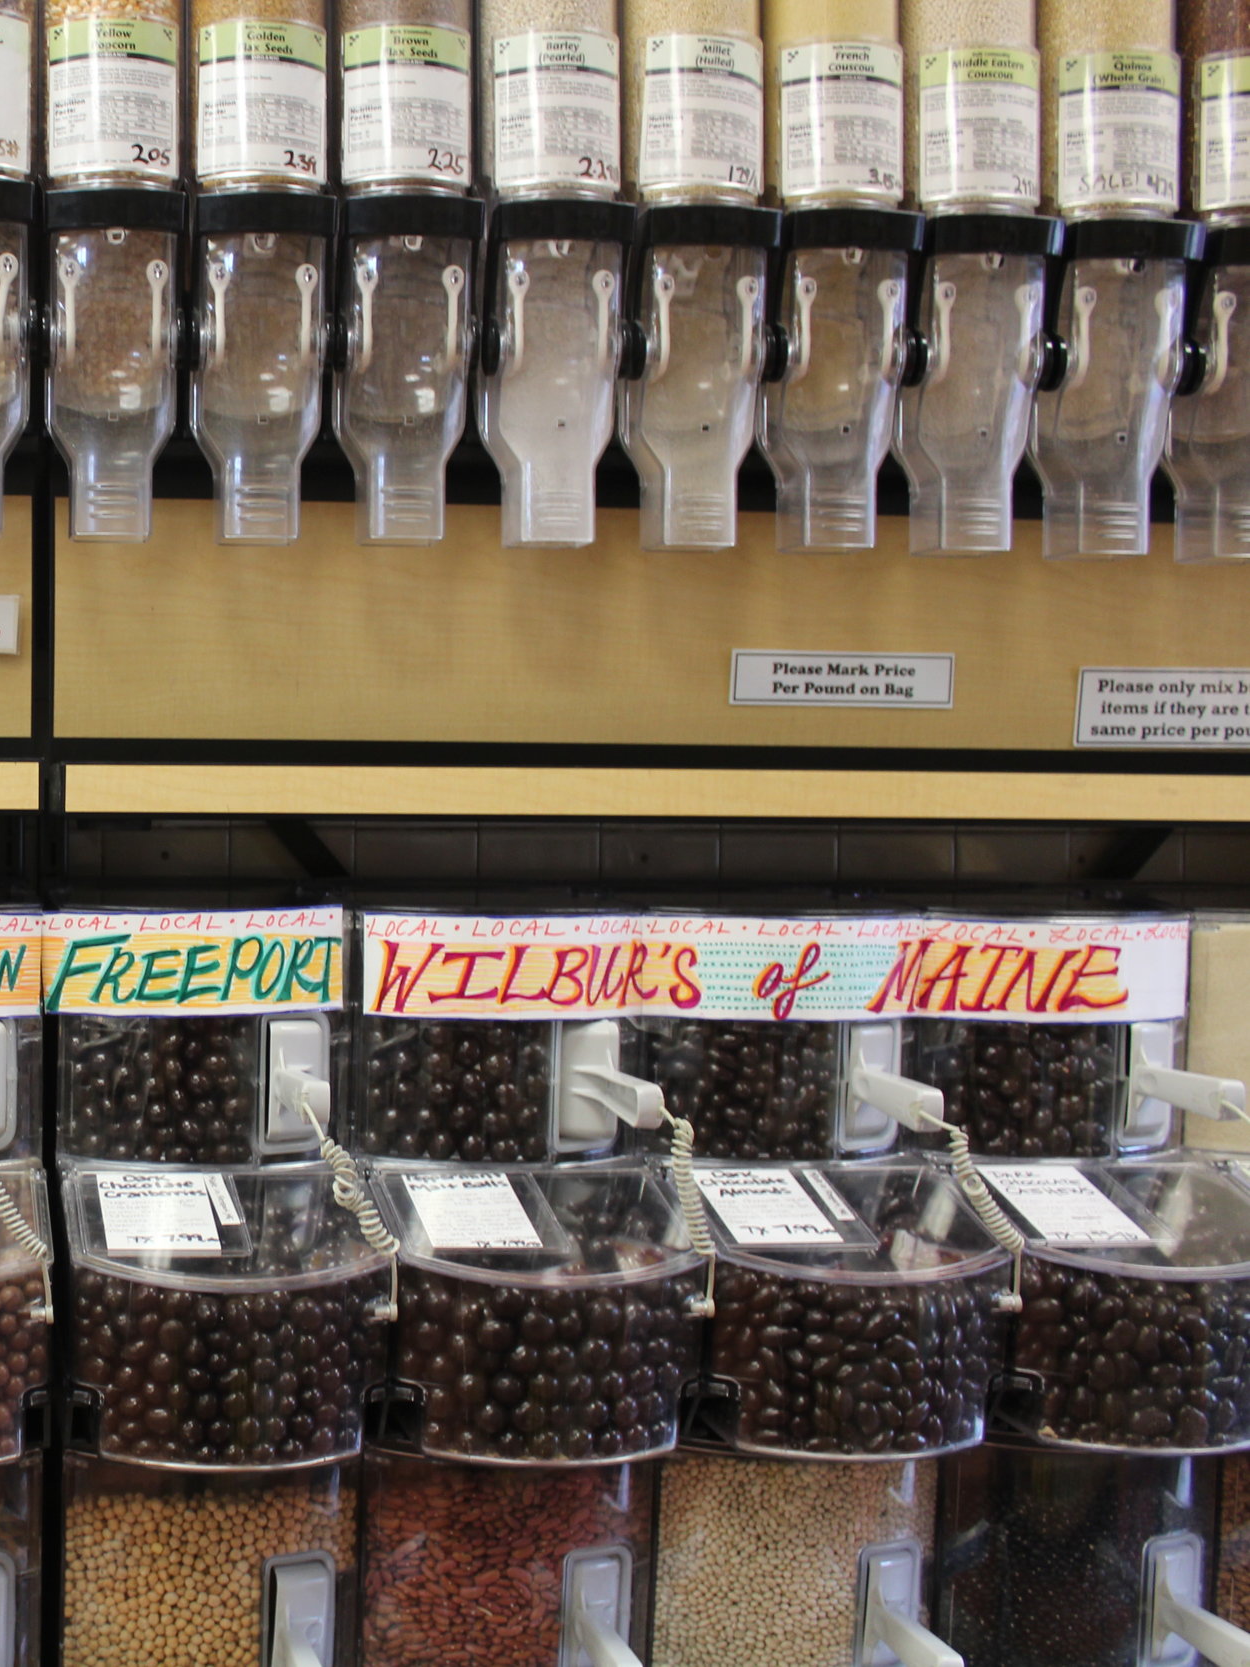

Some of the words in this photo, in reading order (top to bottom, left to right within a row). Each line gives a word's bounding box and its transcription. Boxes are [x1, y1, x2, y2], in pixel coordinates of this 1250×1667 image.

[96, 27, 133, 39] Yellow
[247, 31, 287, 42] Golden
[91, 41, 138, 52] opcorn
[393, 35, 430, 47] Brown
[546, 41, 580, 53] Barley
[264, 43, 294, 55] Seeds
[409, 47, 439, 59] Seeds
[701, 44, 732, 57] Millet
[538, 52, 586, 66] (Pearled)
[835, 51, 871, 62] French
[828, 63, 876, 74] Couscous
[951, 57, 990, 69] Middle
[991, 58, 1025, 71] Eastern
[1113, 60, 1153, 71] Quinoa
[966, 70, 1015, 81] Couscous
[772, 661, 824, 676] Please
[826, 663, 870, 677] Mark
[874, 663, 917, 677] Price
[771, 681, 801, 695] Per
[803, 682, 856, 696] Pound
[859, 685, 881, 696] on
[883, 683, 915, 699] Bag
[1097, 678, 1155, 694] Please
[1158, 680, 1196, 698] only
[1200, 680, 1234, 694] mix
[1100, 700, 1150, 716] items
[1153, 700, 1167, 716] if
[1169, 700, 1207, 719] they
[1210, 704, 1240, 716] are
[1090, 725, 1137, 737] same
[1140, 722, 1187, 740] price
[1189, 725, 1221, 741] per
[48, 915, 118, 931] LOCAL
[138, 913, 224, 931] LOCAL
[245, 911, 327, 929] LOCAL
[367, 918, 446, 938] LOCAL
[471, 919, 567, 936] LOCAL
[587, 917, 643, 935] LOCAL
[649, 918, 731, 936] LOCAL
[758, 919, 842, 936] LOCAL
[857, 920, 919, 938] LOCAL
[925, 922, 1024, 943] LOCAL
[1048, 922, 1138, 943] LOCAL
[45, 933, 343, 1013] FREEPORT
[370, 939, 703, 1014] WILBUR'S
[752, 940, 830, 1021] of
[865, 938, 1130, 1014] MAINE
